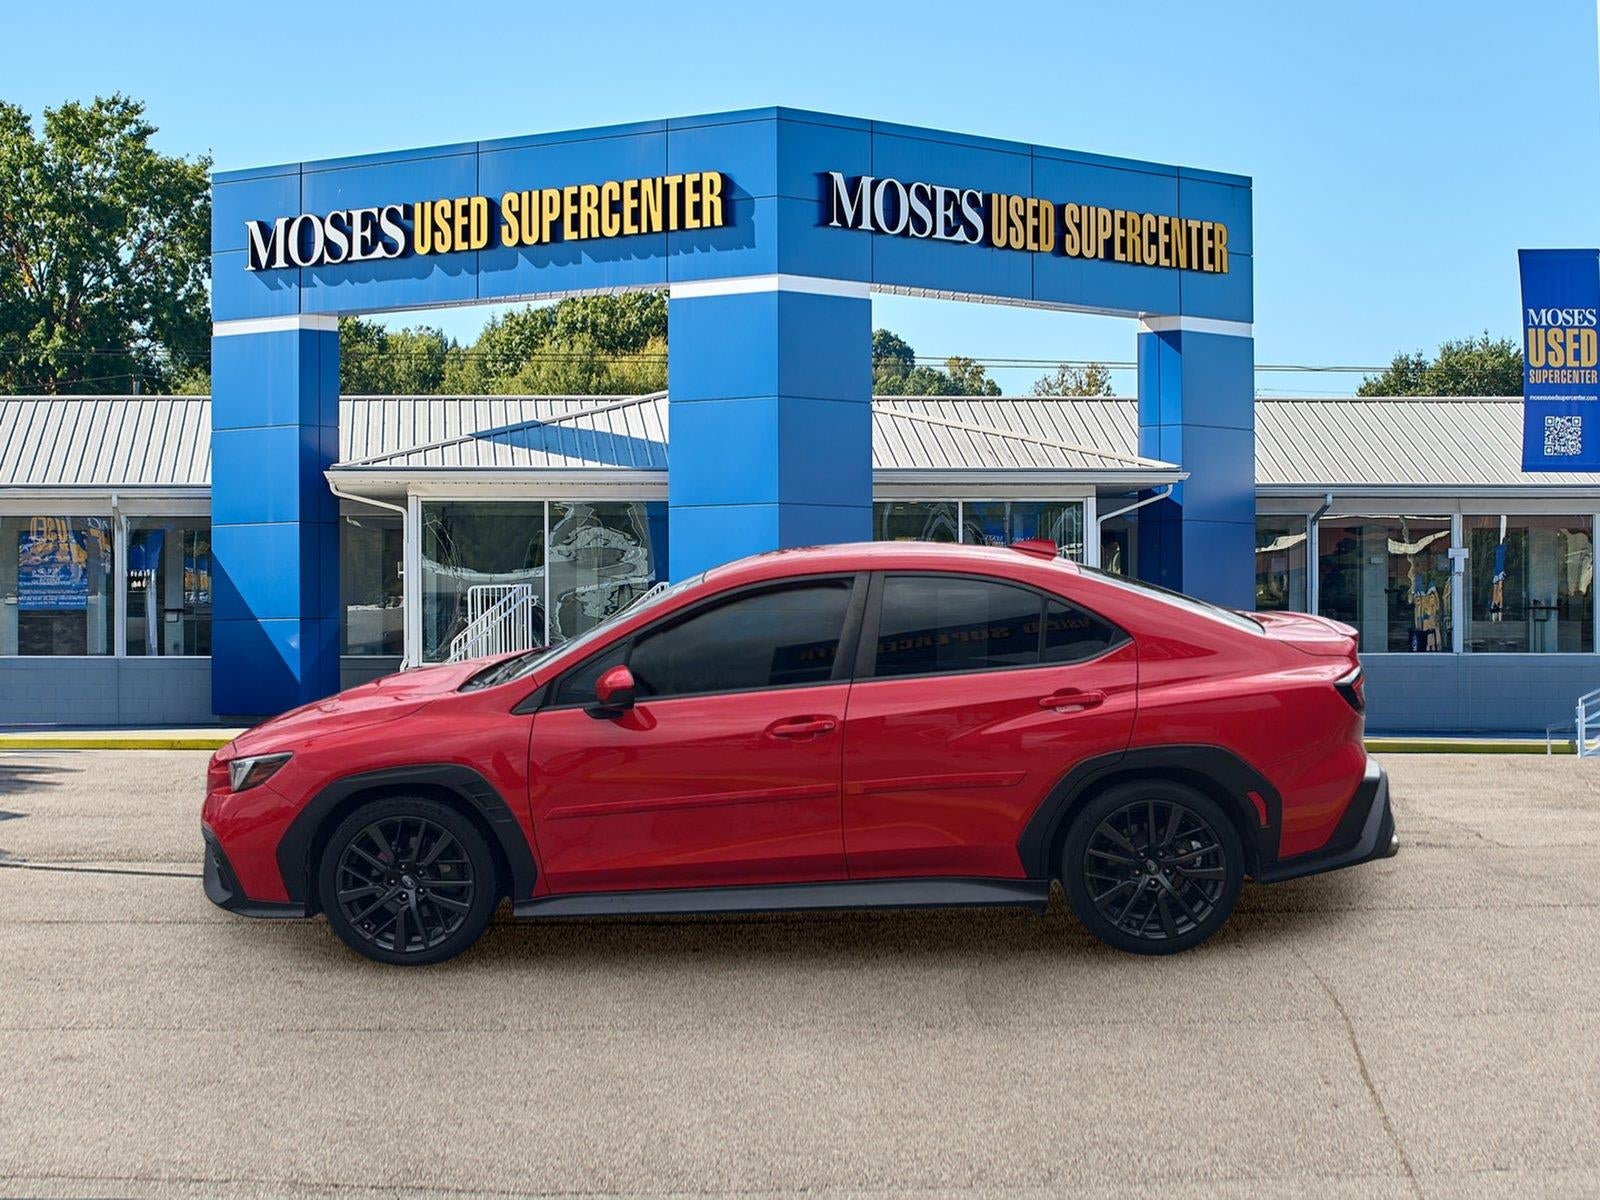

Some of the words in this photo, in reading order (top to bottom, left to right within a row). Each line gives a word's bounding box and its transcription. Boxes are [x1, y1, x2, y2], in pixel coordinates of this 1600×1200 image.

[244, 205, 407, 272] MOSES
[413, 195, 489, 255] USED
[501, 170, 724, 248] SUPERCENTER
[829, 171, 985, 244] MOSES
[991, 192, 1055, 252] USED
[1064, 203, 1229, 273] SUPERCENTER
[1528, 308, 1597, 326] MOSES
[1528, 328, 1598, 367] USED
[1529, 369, 1598, 384] SUPERCENTER
[1529, 394, 1598, 402] mosesusedsupercenter.com
